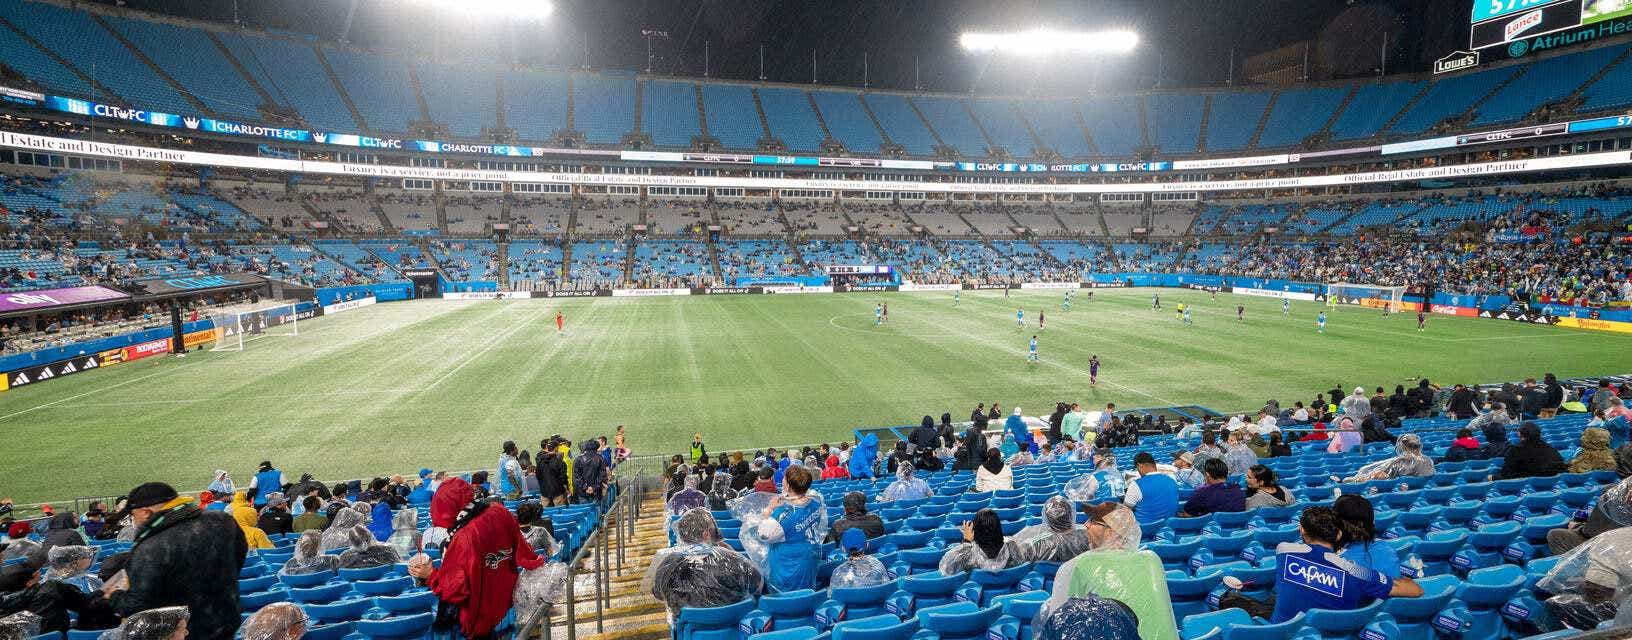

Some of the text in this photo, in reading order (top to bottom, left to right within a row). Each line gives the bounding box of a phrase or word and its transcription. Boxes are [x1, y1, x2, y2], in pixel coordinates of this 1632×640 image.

[1507, 12, 1540, 35] Lance
[1532, 28, 1595, 49] Atrium
[1438, 55, 1475, 72] LOWE'S
[216, 122, 297, 139] CHARLOTTE FC
[10, 134, 54, 148] Estate
[59, 141, 84, 151] and
[89, 143, 133, 156] Design
[137, 148, 185, 161] Partner
[441, 143, 493, 153] CHARLOTTE
[1344, 173, 1376, 182] Official
[1400, 170, 1425, 178] Estate
[1428, 168, 1446, 176] and
[1449, 166, 1483, 175] Design
[1486, 162, 1528, 171] Partner
